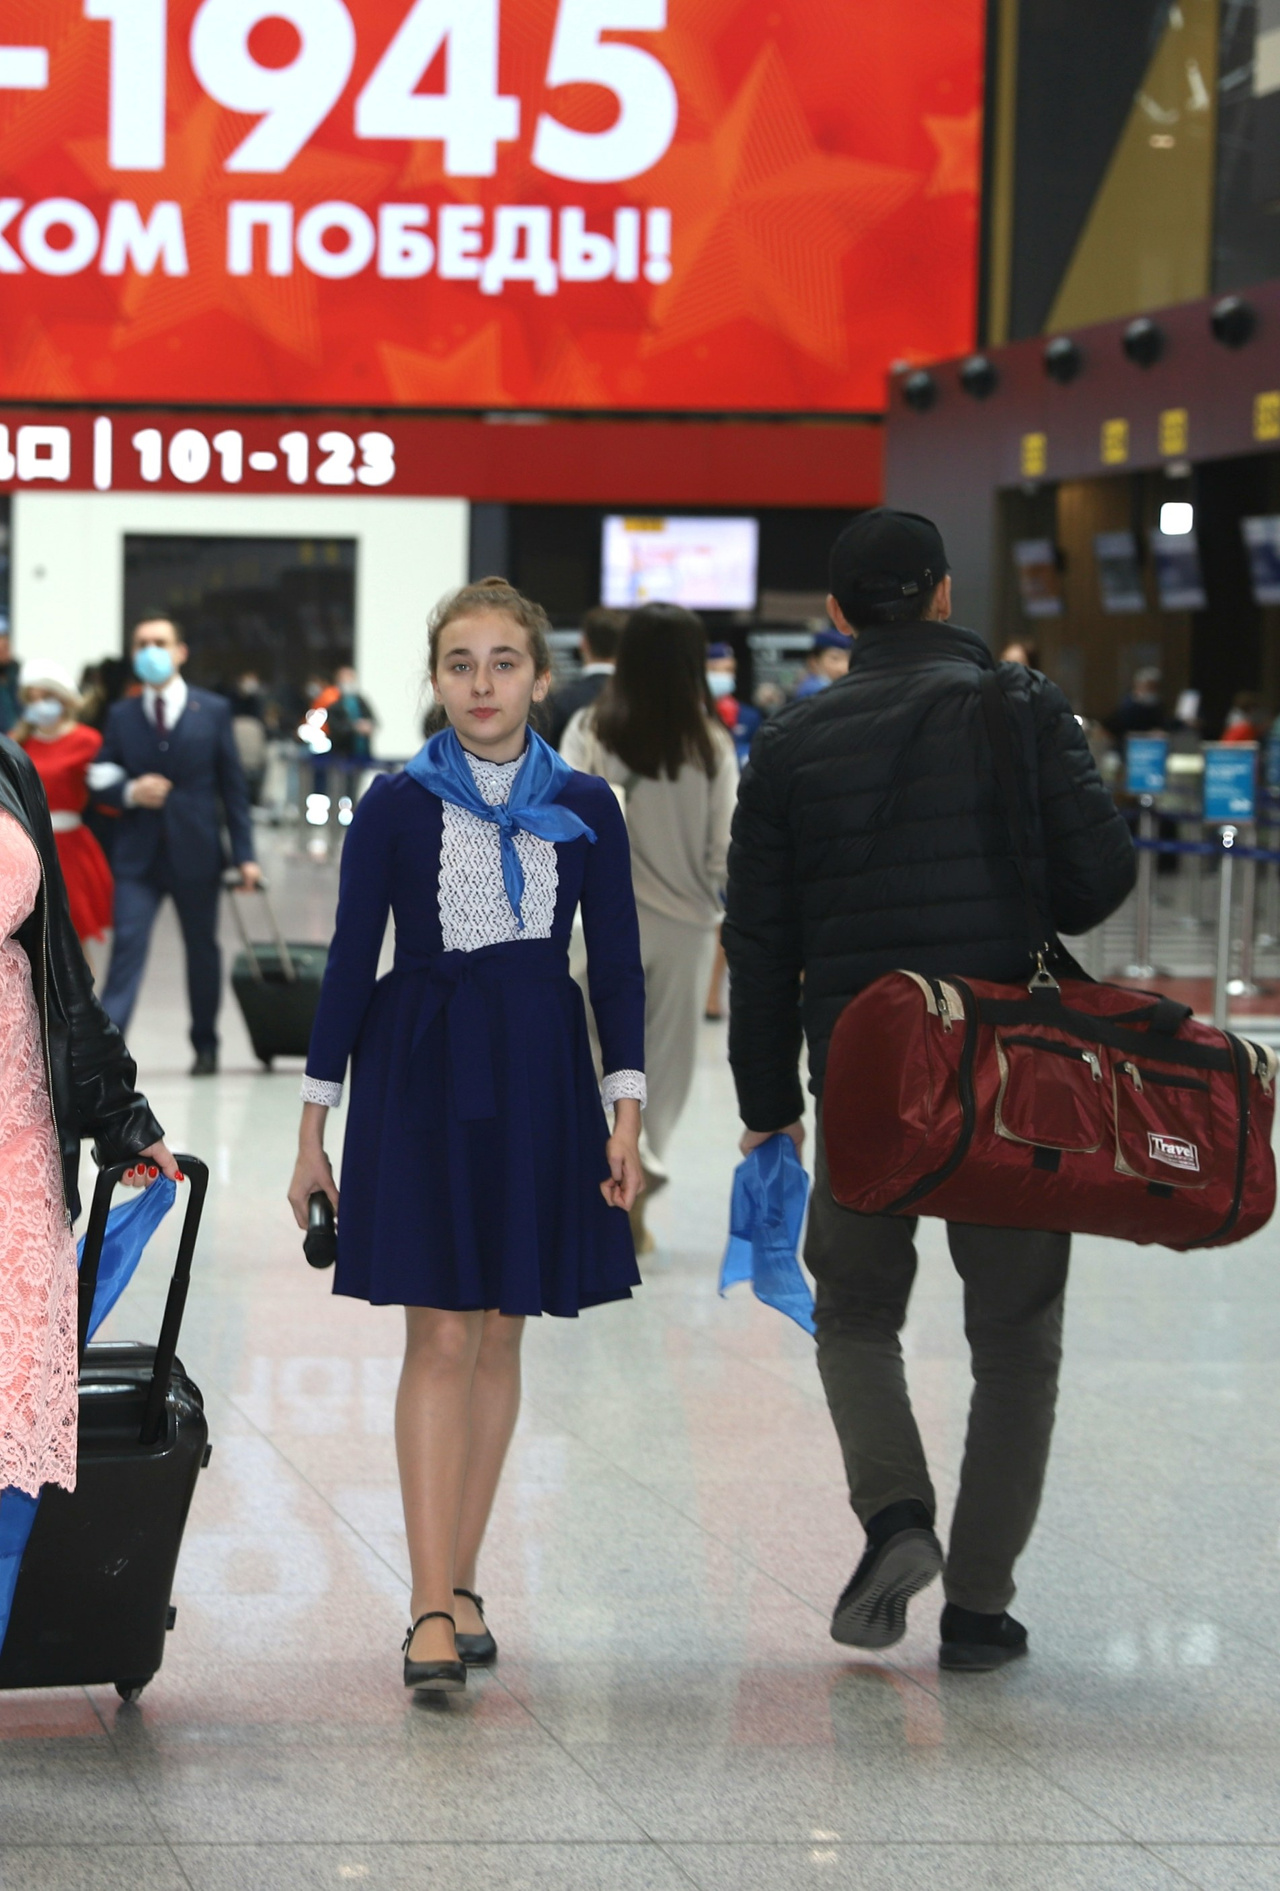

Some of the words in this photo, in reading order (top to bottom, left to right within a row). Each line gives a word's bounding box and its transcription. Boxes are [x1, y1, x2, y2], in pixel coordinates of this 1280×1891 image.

[226, 200, 673, 296] ПОБЕДЫ!
[131, 428, 397, 486] 101-123
[1151, 1136, 1195, 1158] Travel
